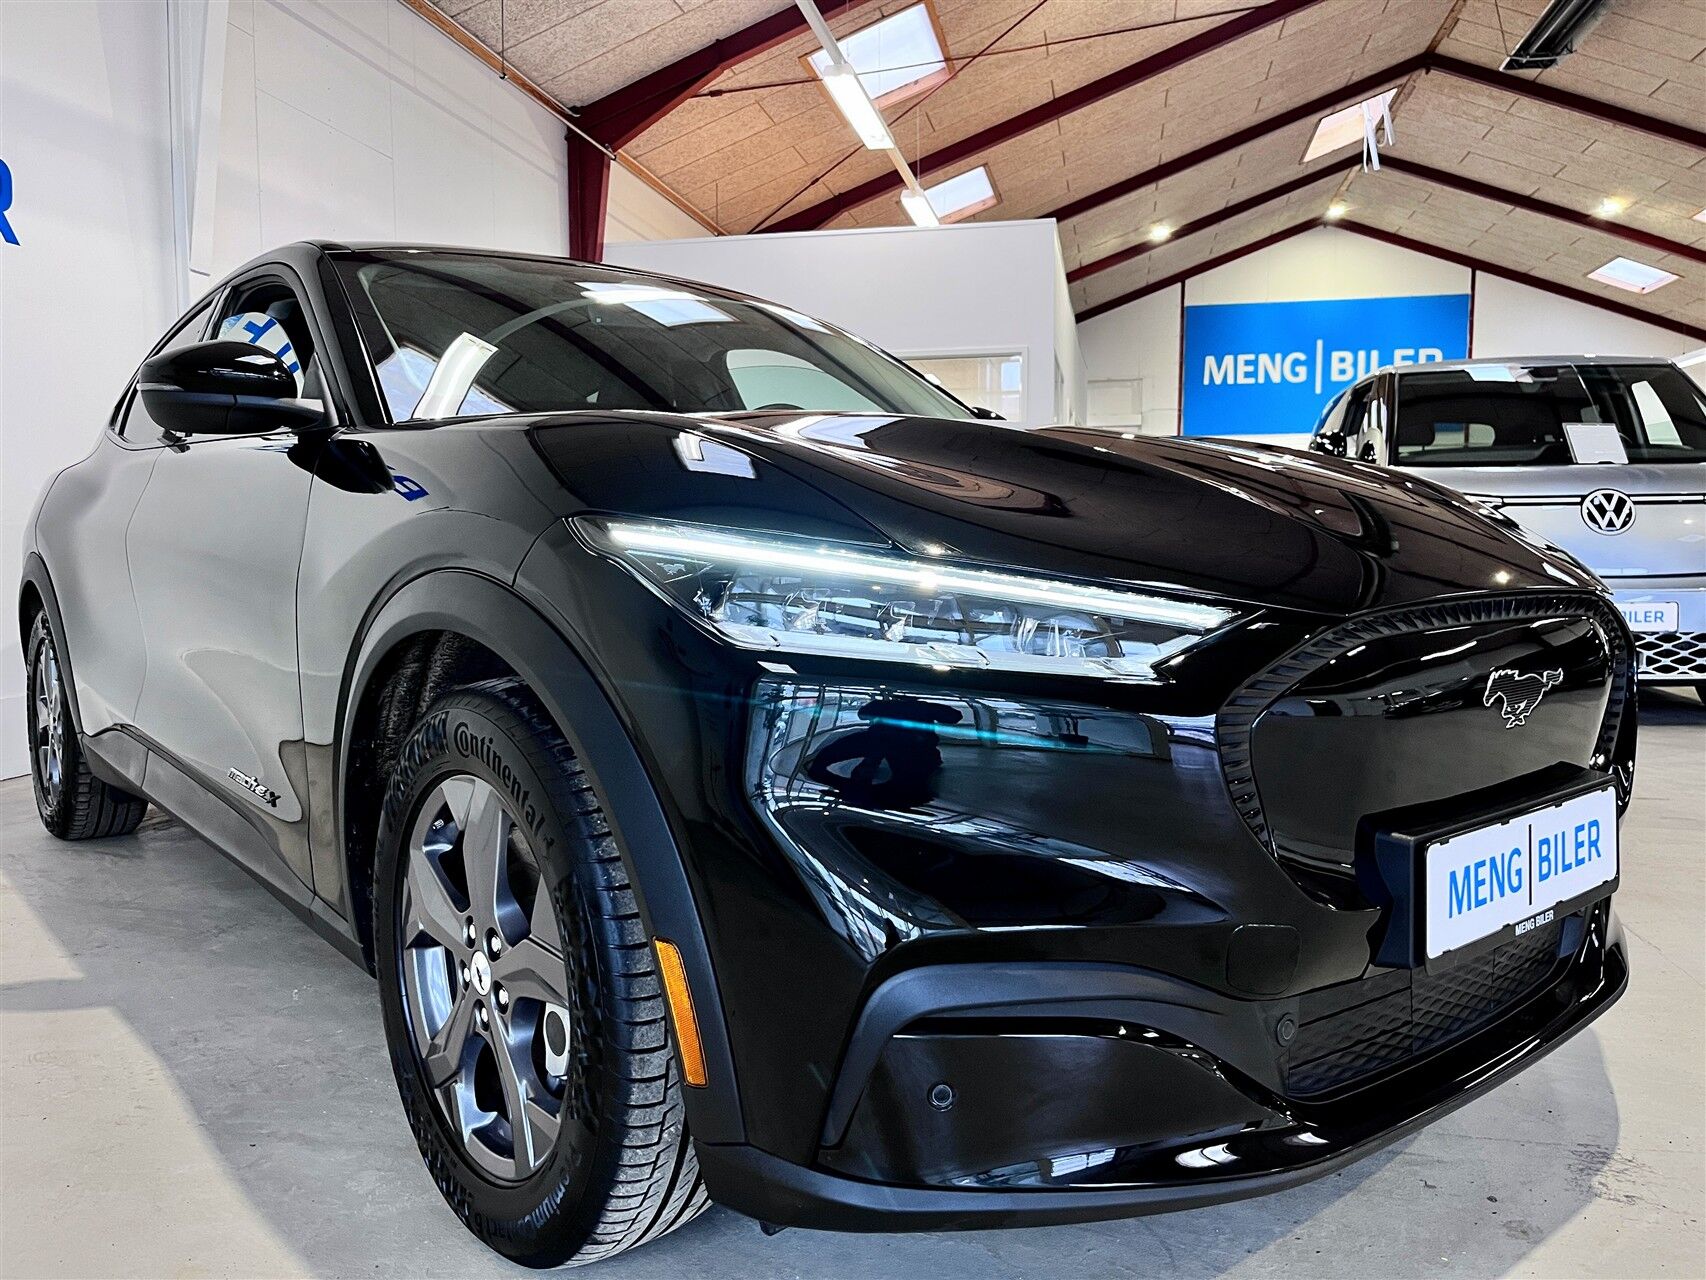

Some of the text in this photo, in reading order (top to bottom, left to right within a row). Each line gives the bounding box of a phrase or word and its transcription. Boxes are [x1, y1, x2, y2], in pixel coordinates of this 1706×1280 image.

[1203, 352, 1307, 386] MENG
[453, 721, 546, 837] Continental
[1448, 818, 1602, 919] MENG BILER
[1515, 909, 1554, 936] MENG BILER
